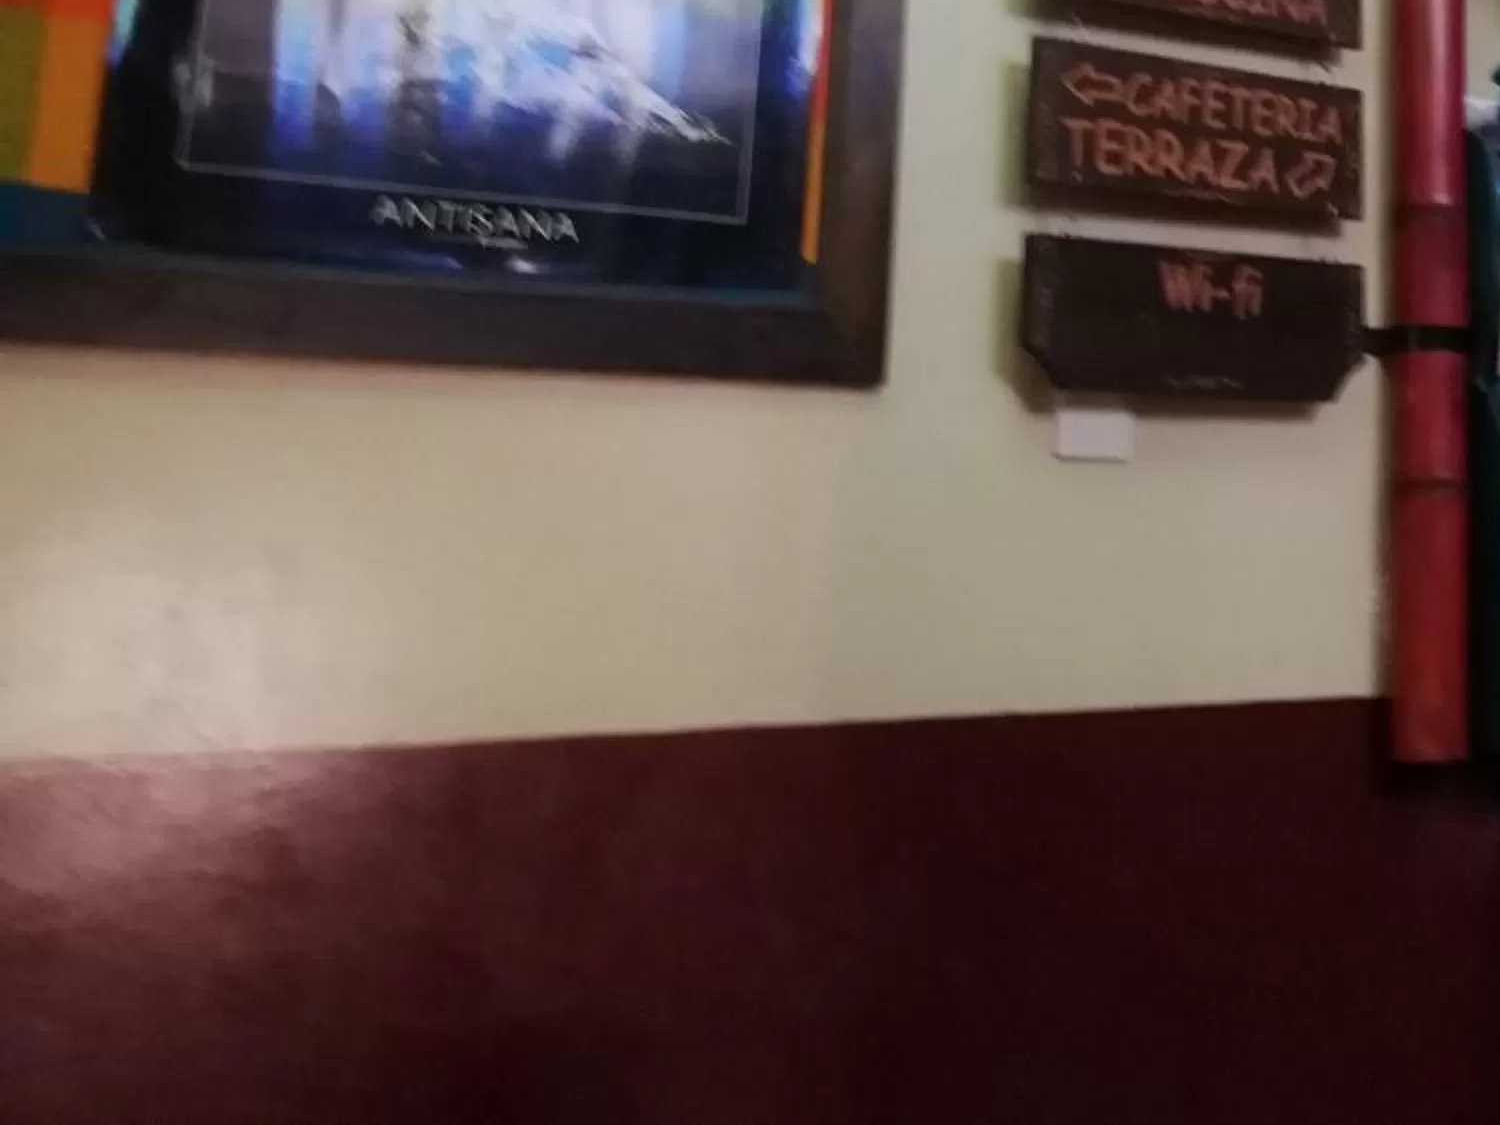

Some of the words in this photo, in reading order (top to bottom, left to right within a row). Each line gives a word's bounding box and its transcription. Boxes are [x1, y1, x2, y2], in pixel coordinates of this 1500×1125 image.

[1124, 73, 1343, 146] CAFETERIA
[1060, 116, 1280, 195] TERRAZA
[370, 194, 580, 244] ANTISANA
